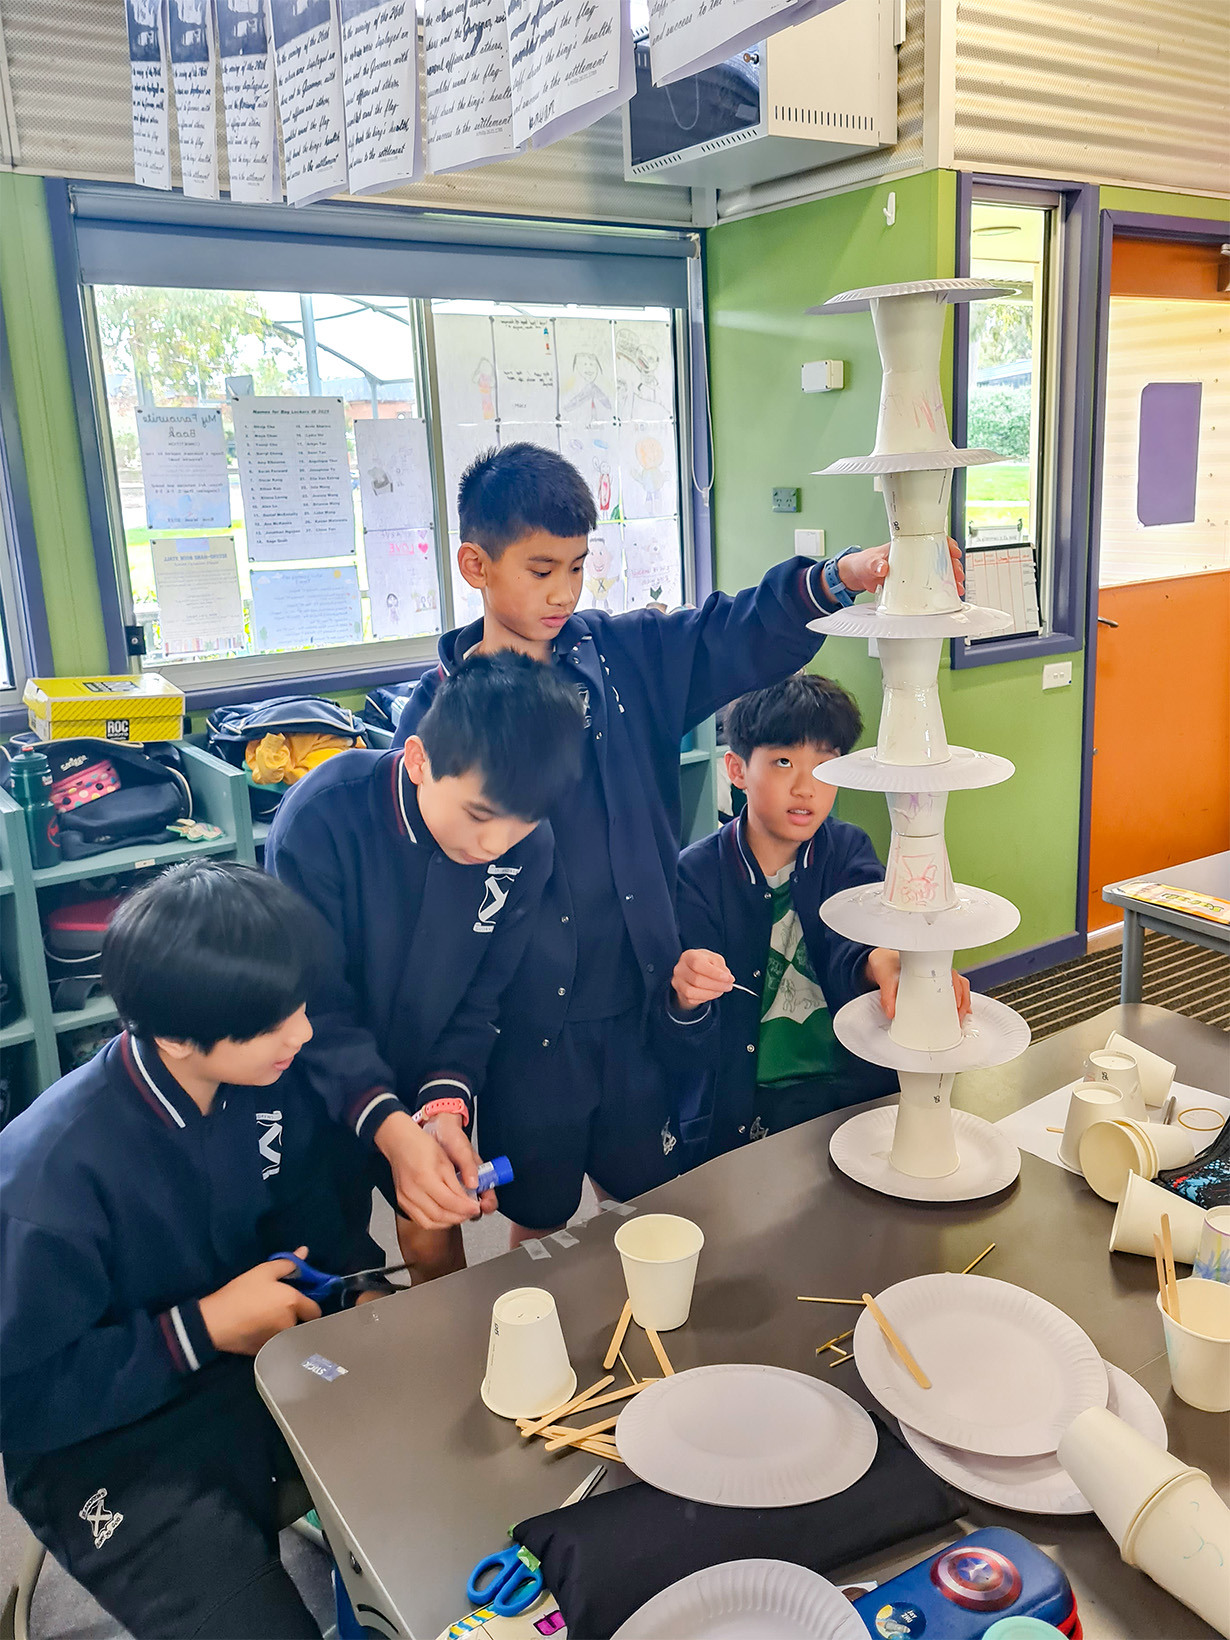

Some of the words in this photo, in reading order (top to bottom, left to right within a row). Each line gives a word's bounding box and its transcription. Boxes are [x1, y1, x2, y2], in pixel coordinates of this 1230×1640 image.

[560, 11, 571, 28] the
[652, 22, 666, 46] and
[666, 14, 692, 36] success
[699, 1, 706, 16] to
[480, 38, 502, 54] others,
[545, 49, 554, 65] the
[471, 68, 479, 82] the
[483, 63, 502, 84] flag-
[542, 81, 548, 94] to
[550, 72, 560, 89] the
[564, 51, 608, 81] settlement
[384, 99, 399, 117] flag-
[457, 97, 466, 110] the
[456, 126, 460, 135] to
[462, 120, 471, 133] the
[474, 113, 512, 130] settlement
[378, 143, 406, 158] settlement
[108, 720, 128, 734] ROC
